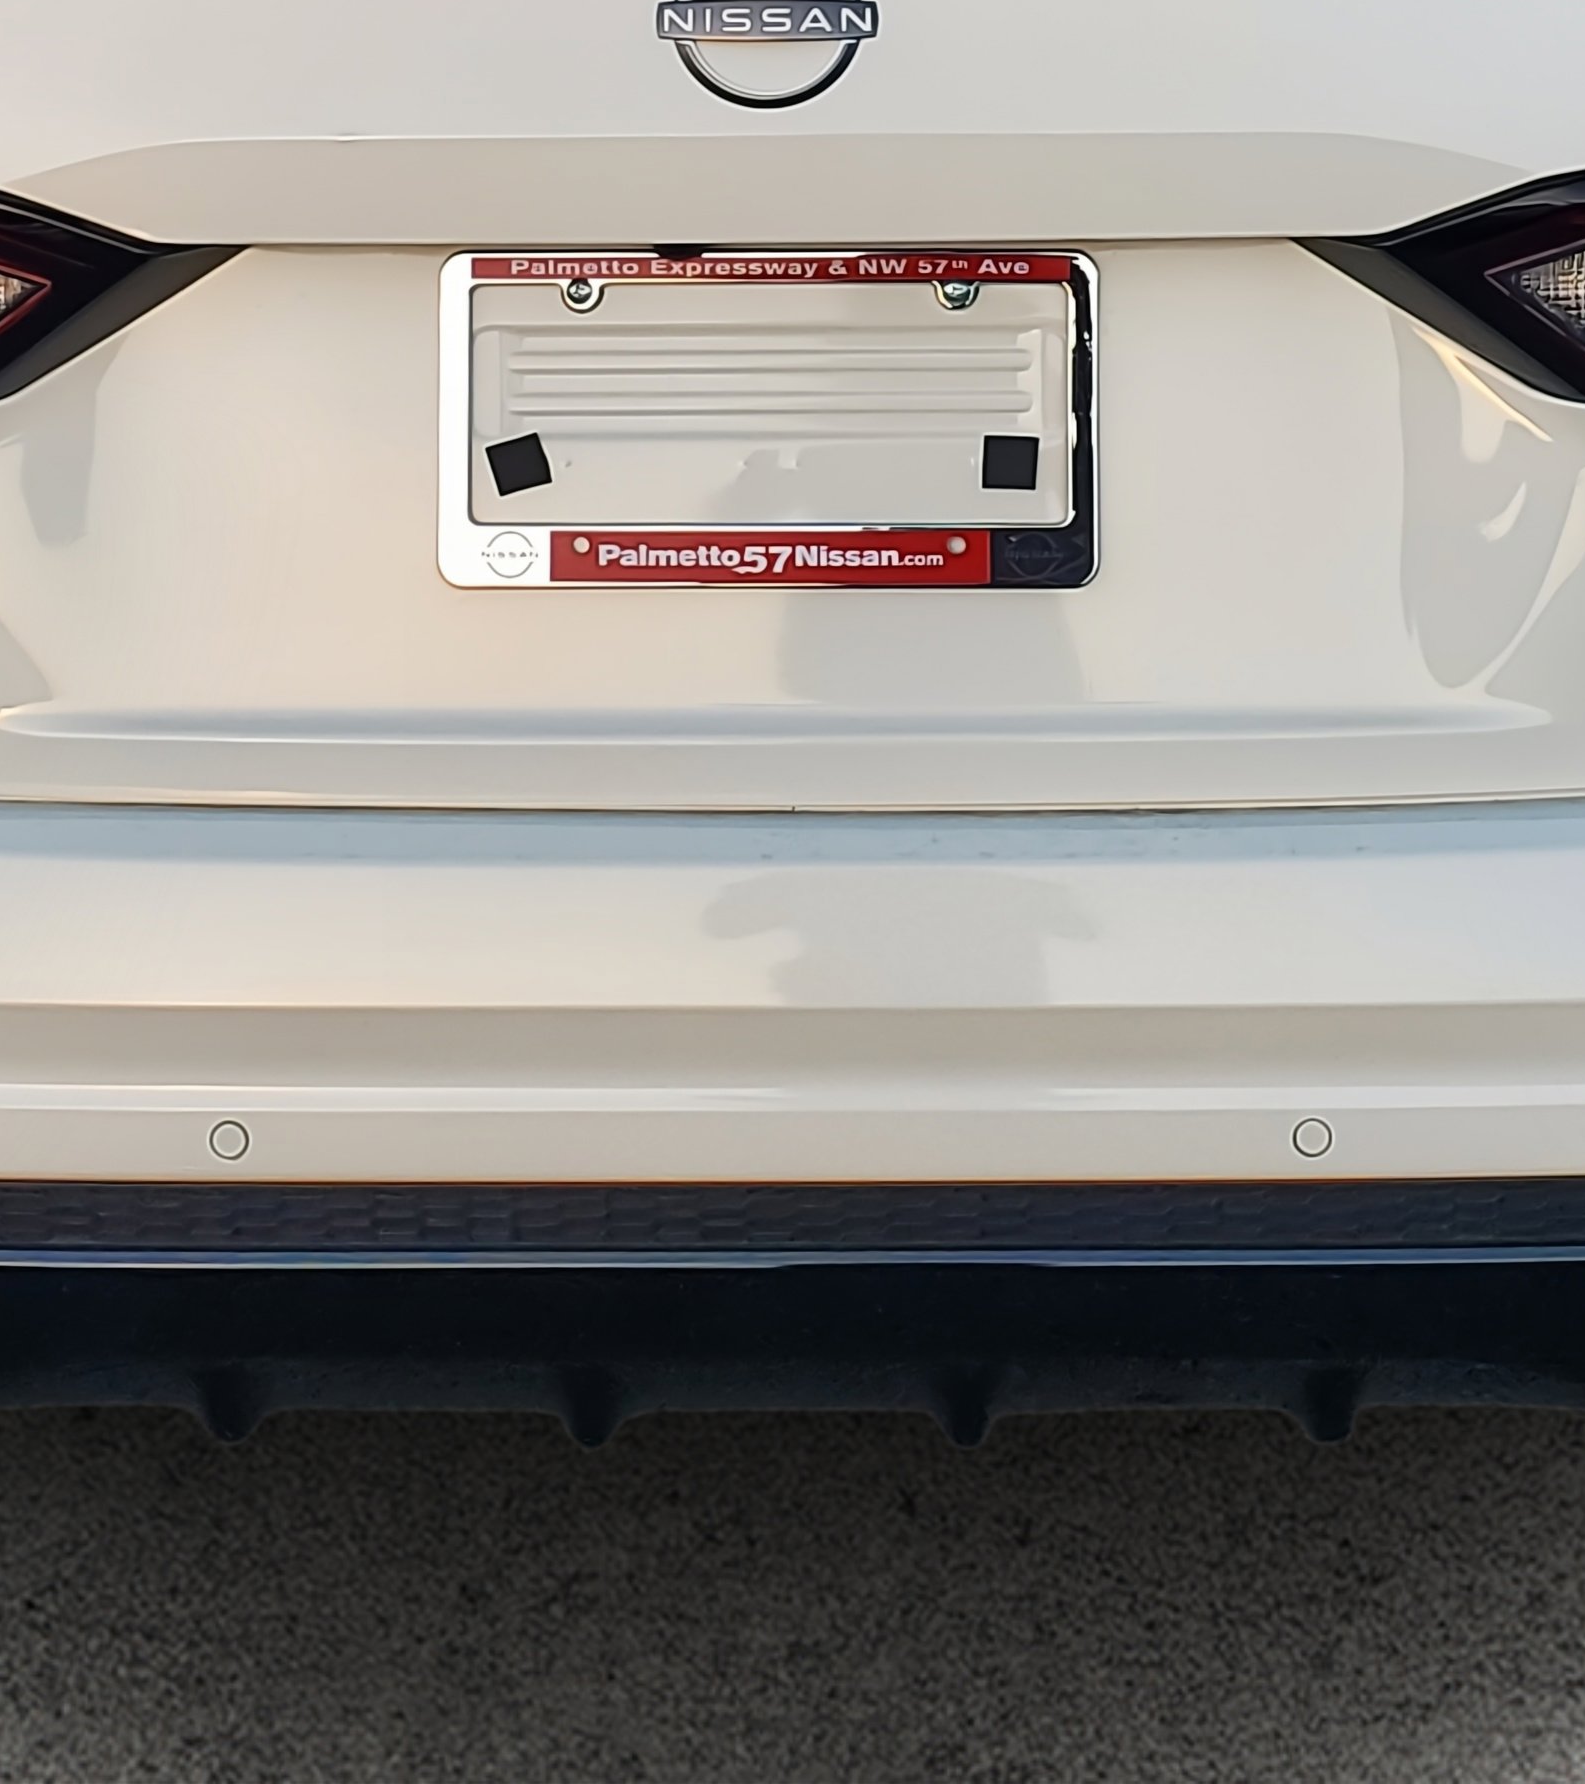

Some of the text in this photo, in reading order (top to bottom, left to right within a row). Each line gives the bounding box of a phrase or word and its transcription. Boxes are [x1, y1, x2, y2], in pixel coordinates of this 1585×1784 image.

[663, 7, 873, 33] NISSAN
[510, 259, 639, 276] Palmetto
[650, 259, 819, 278] Expressway
[828, 259, 848, 276] &
[858, 258, 908, 275] NW
[977, 258, 1031, 275] Ave
